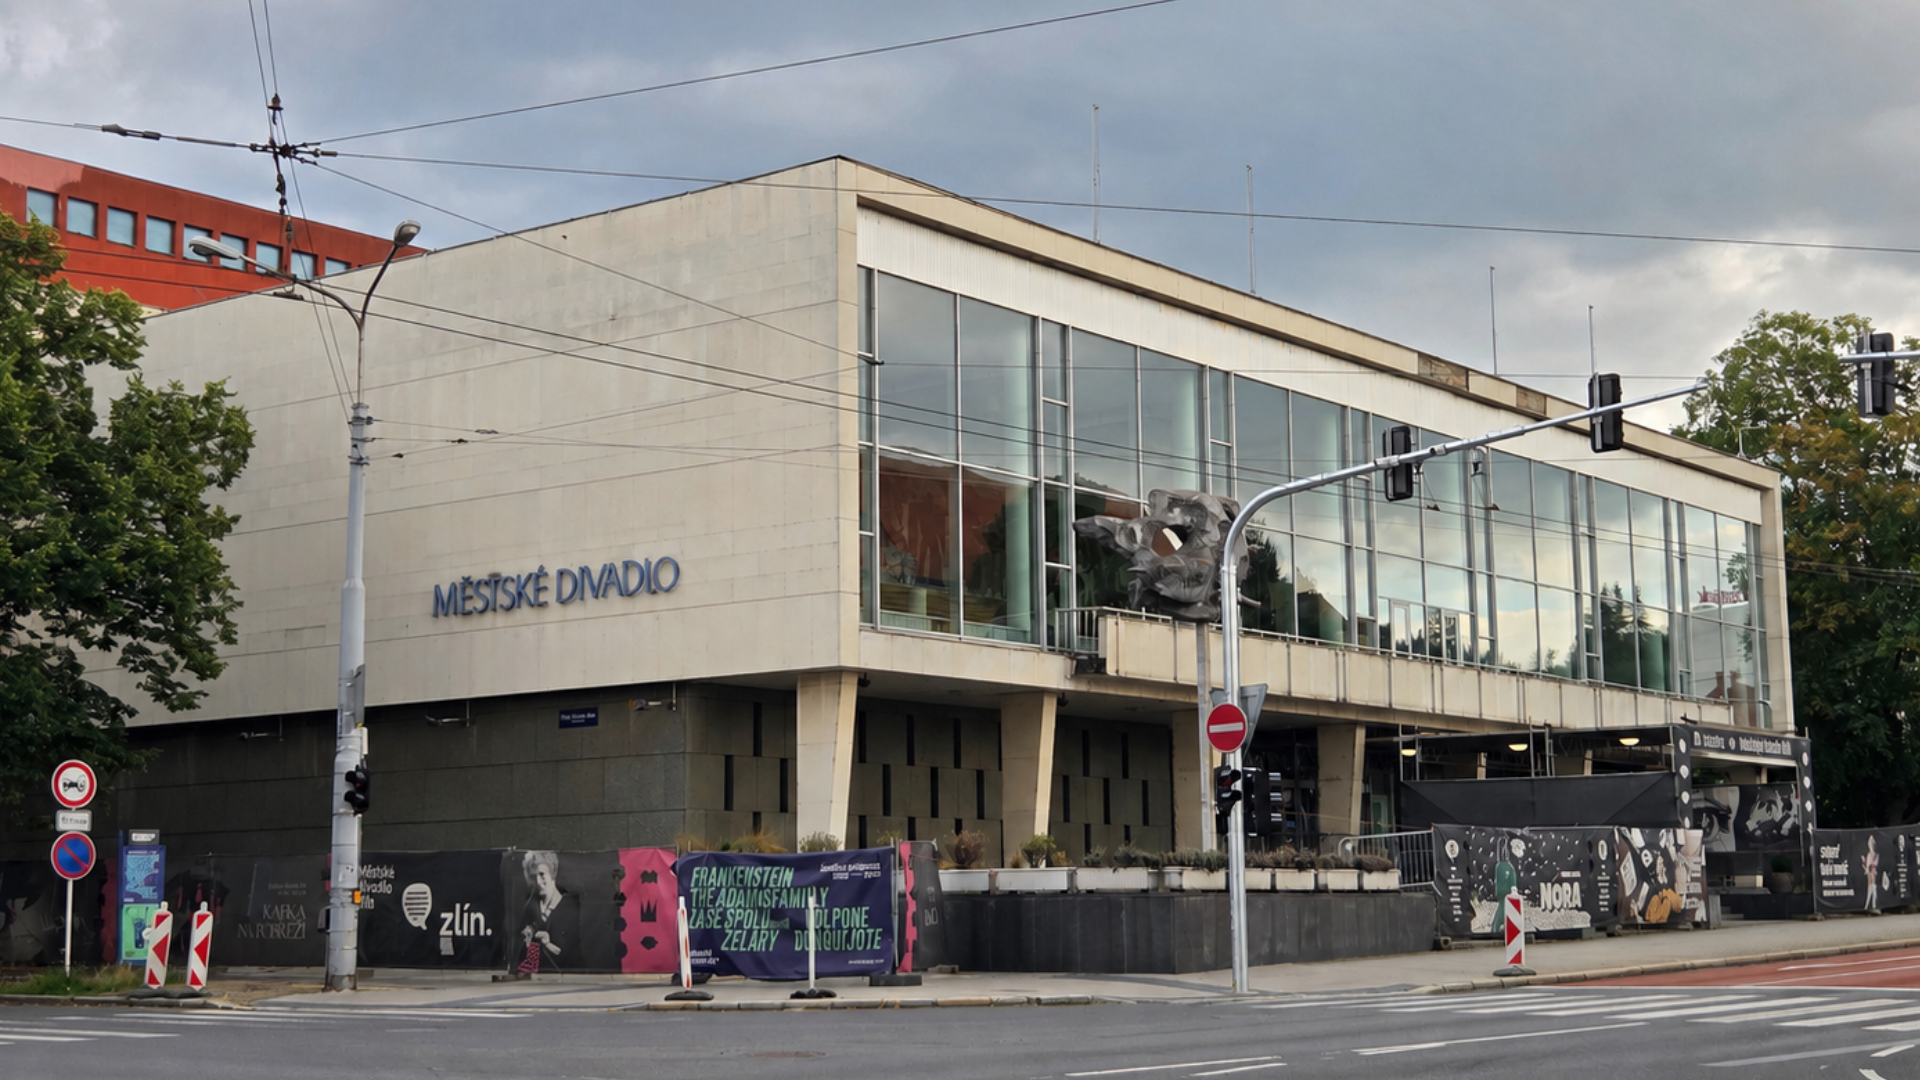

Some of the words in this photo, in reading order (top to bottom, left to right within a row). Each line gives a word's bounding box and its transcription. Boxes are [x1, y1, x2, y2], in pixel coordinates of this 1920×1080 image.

[432, 564, 549, 618] MĚSTSKÉ
[555, 556, 680, 605] DIVADLO
[690, 866, 794, 889] FRANKENSTEIN
[690, 888, 716, 908] THE
[1539, 881, 1582, 910] NORA
[263, 903, 307, 921] KAFKA
[439, 902, 493, 937] zlín.
